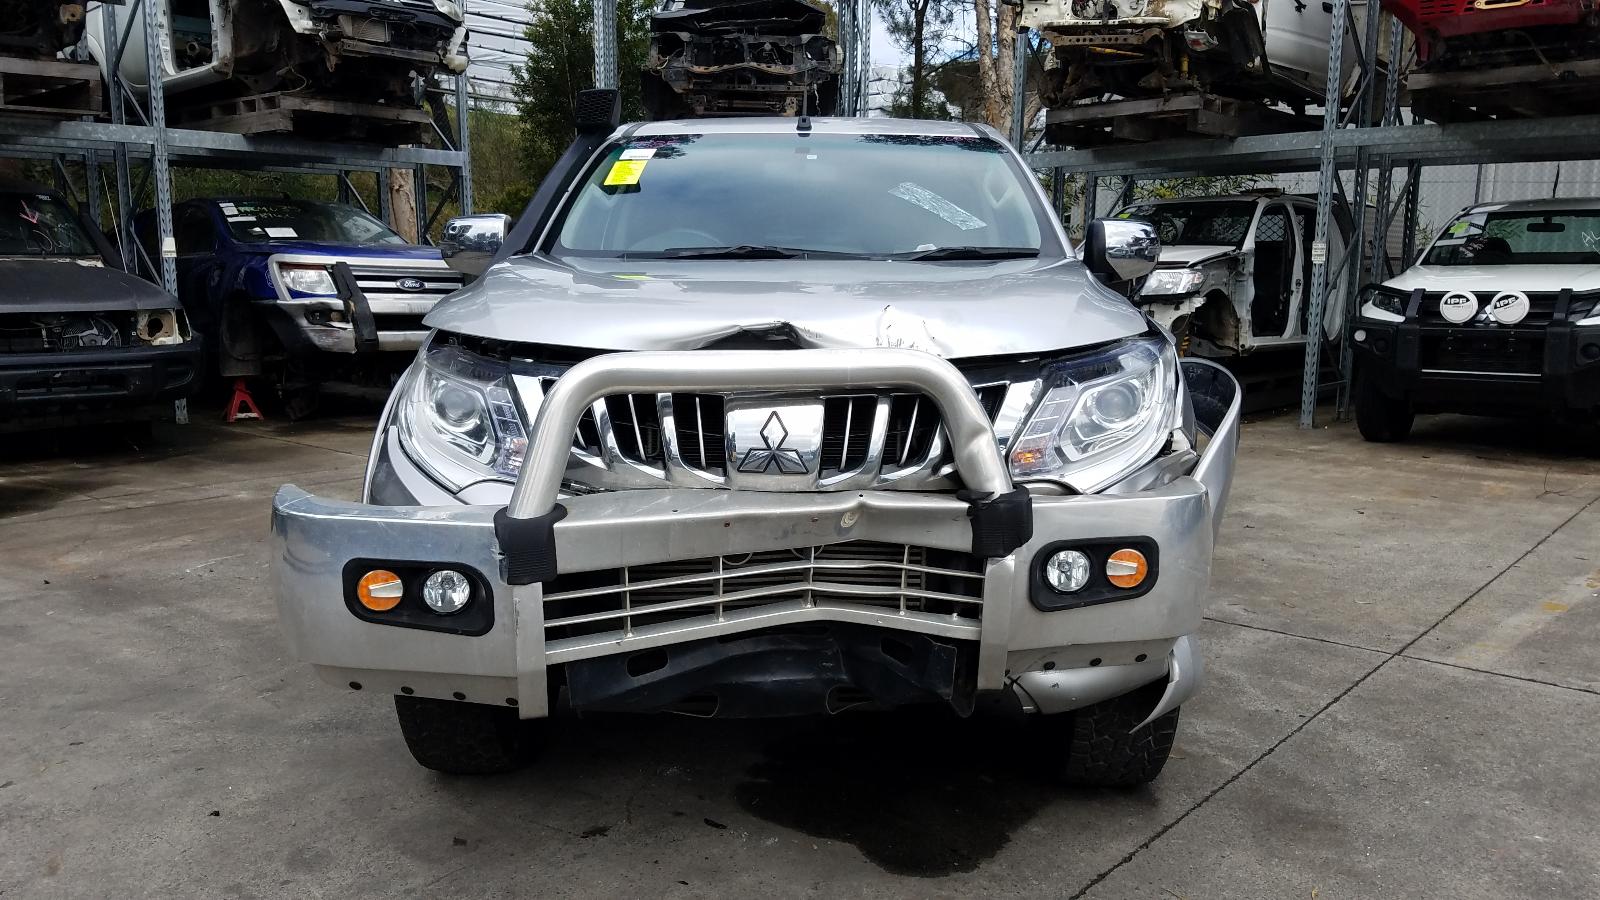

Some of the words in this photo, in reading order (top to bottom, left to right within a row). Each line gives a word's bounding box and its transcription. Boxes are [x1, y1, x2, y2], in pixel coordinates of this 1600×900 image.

[404, 280, 420, 288] Ford
[1447, 297, 1467, 305] IPF
[1496, 296, 1516, 308] IPF
